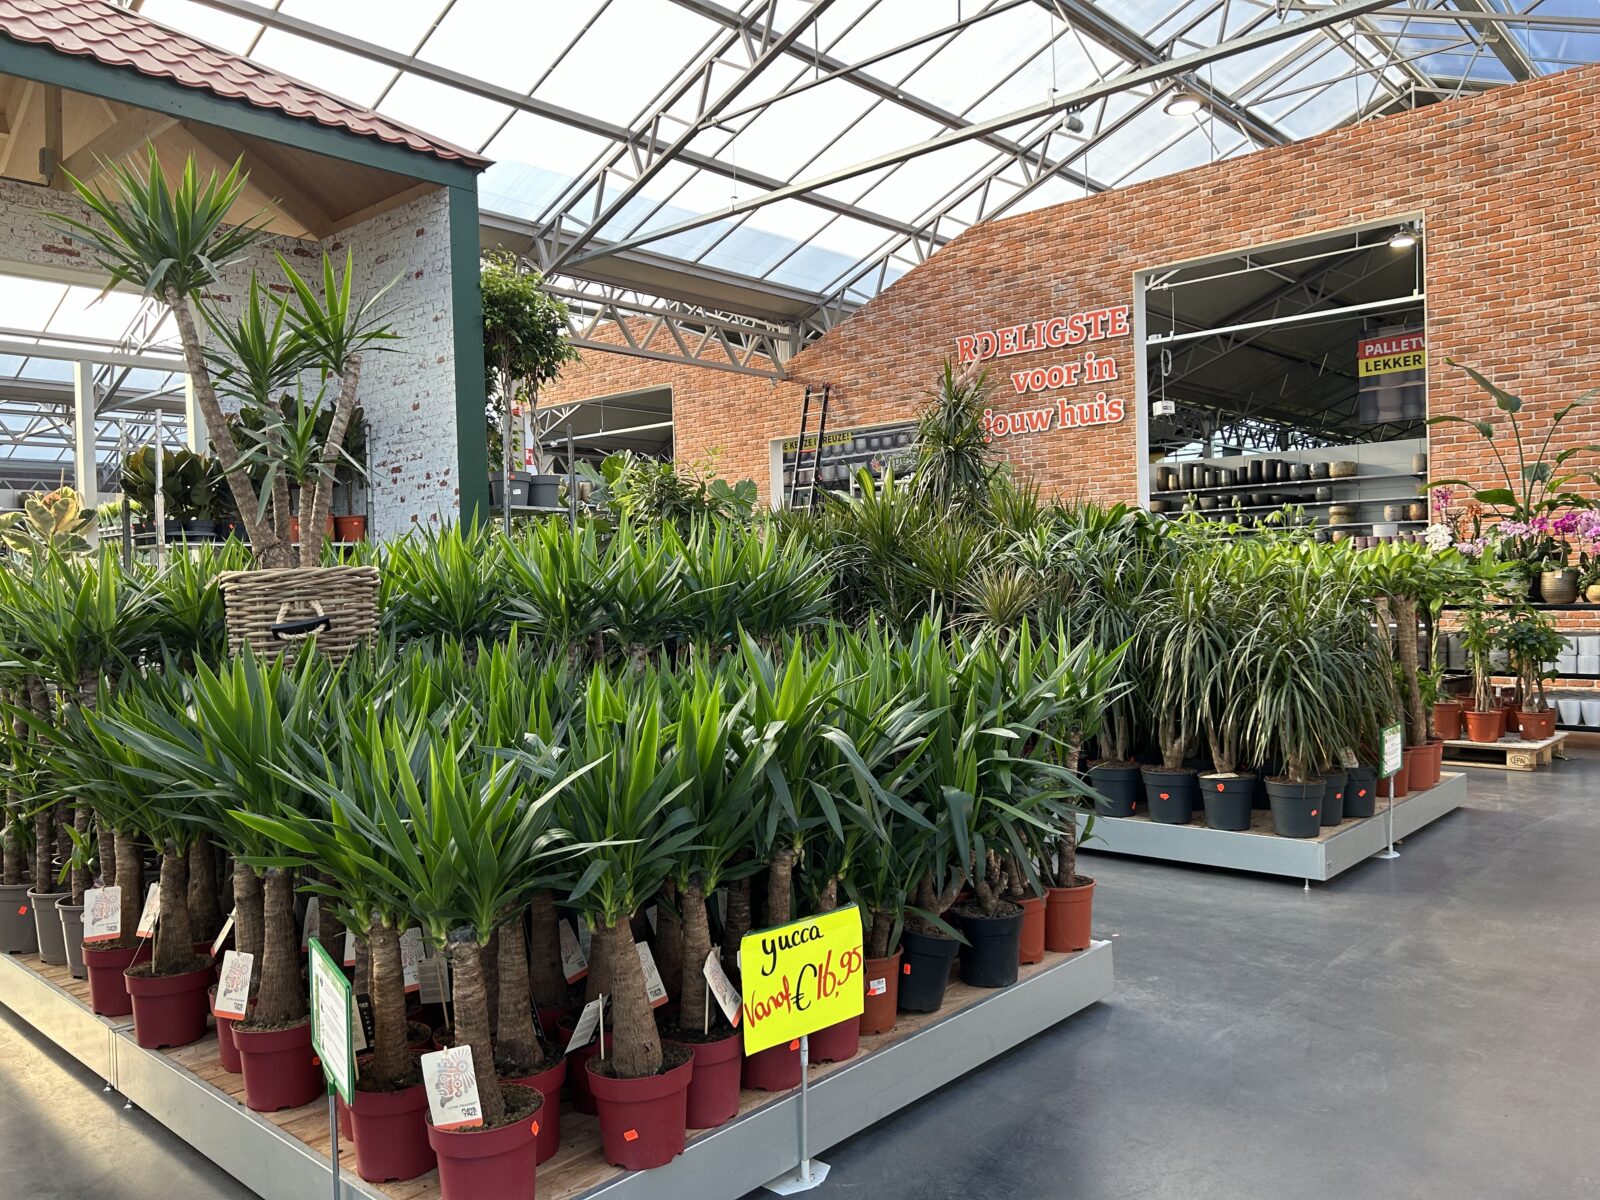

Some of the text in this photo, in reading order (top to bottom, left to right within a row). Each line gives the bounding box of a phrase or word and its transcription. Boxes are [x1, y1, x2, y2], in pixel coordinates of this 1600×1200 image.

[956, 305, 1130, 364] RDELIGSTE
[1011, 351, 1118, 394] voor in
[1365, 354, 1422, 373] LEKKER
[983, 392, 1124, 440] jouw huis
[789, 438, 813, 450] KEZE
[761, 924, 824, 977] yucca
